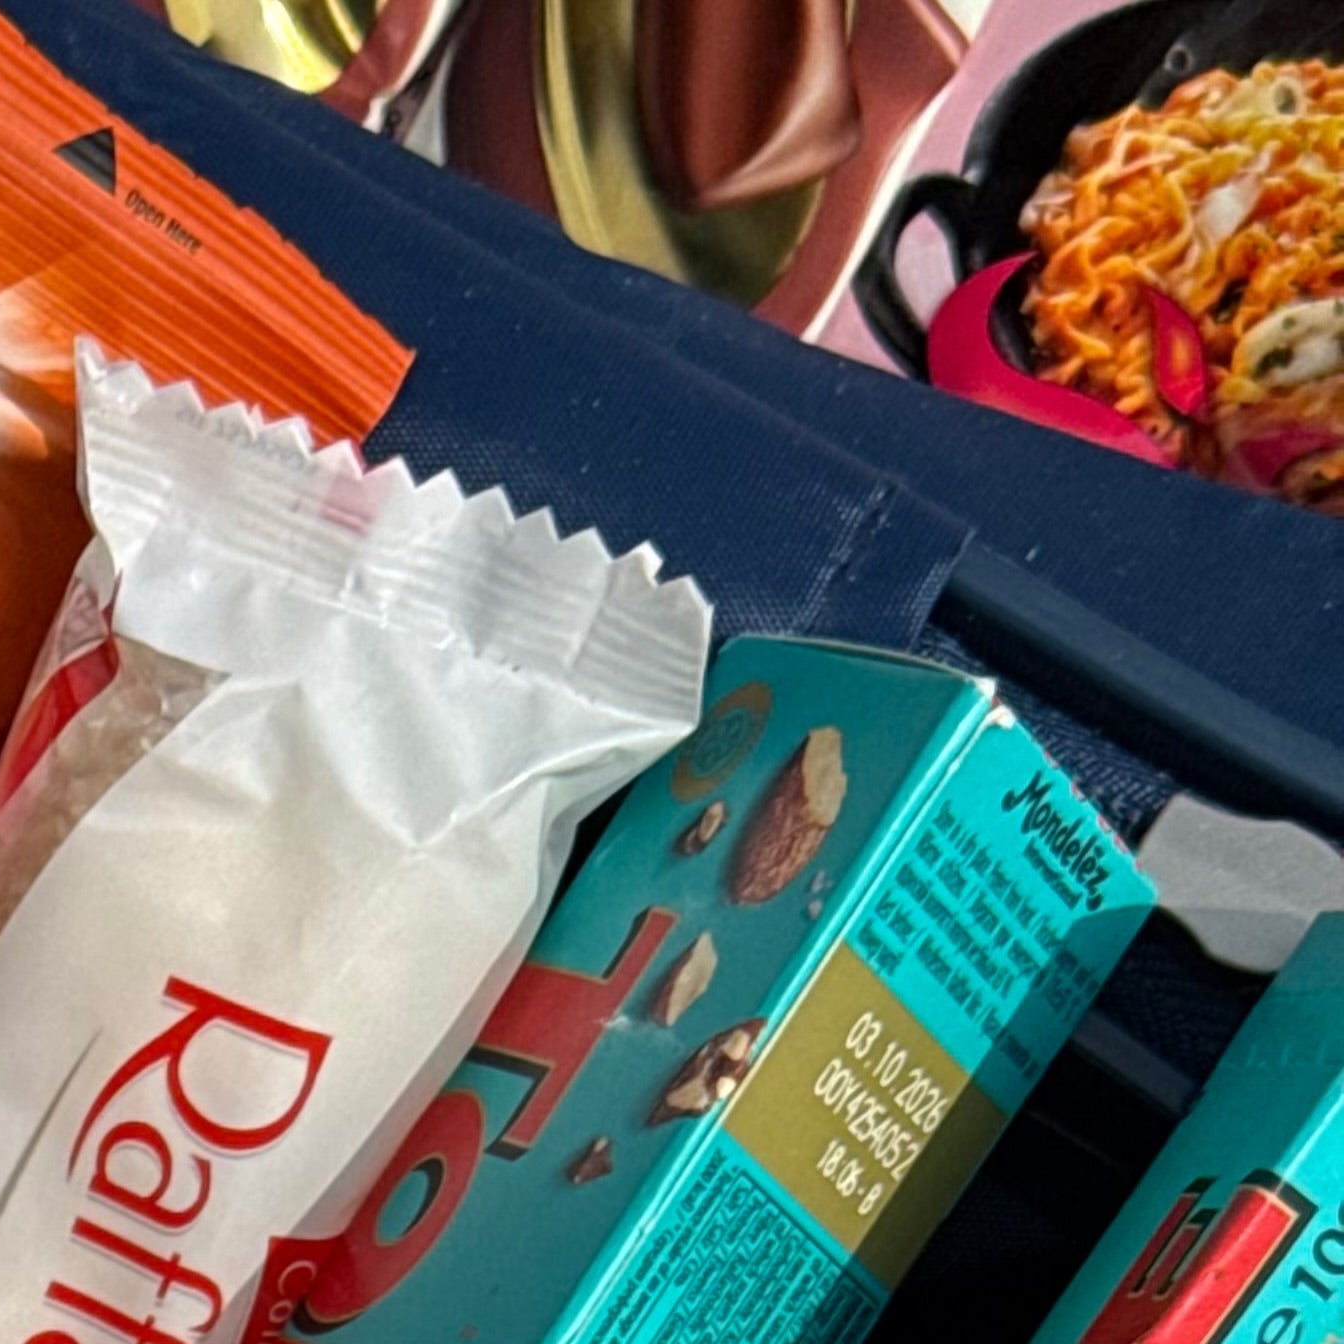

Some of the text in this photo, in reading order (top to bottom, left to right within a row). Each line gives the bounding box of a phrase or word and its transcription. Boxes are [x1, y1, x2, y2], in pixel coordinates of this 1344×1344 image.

[120, 187, 206, 255] Open Here
[844, 1012, 949, 1135] 03.10.2026
[1289, 1204, 1344, 1302] 10
